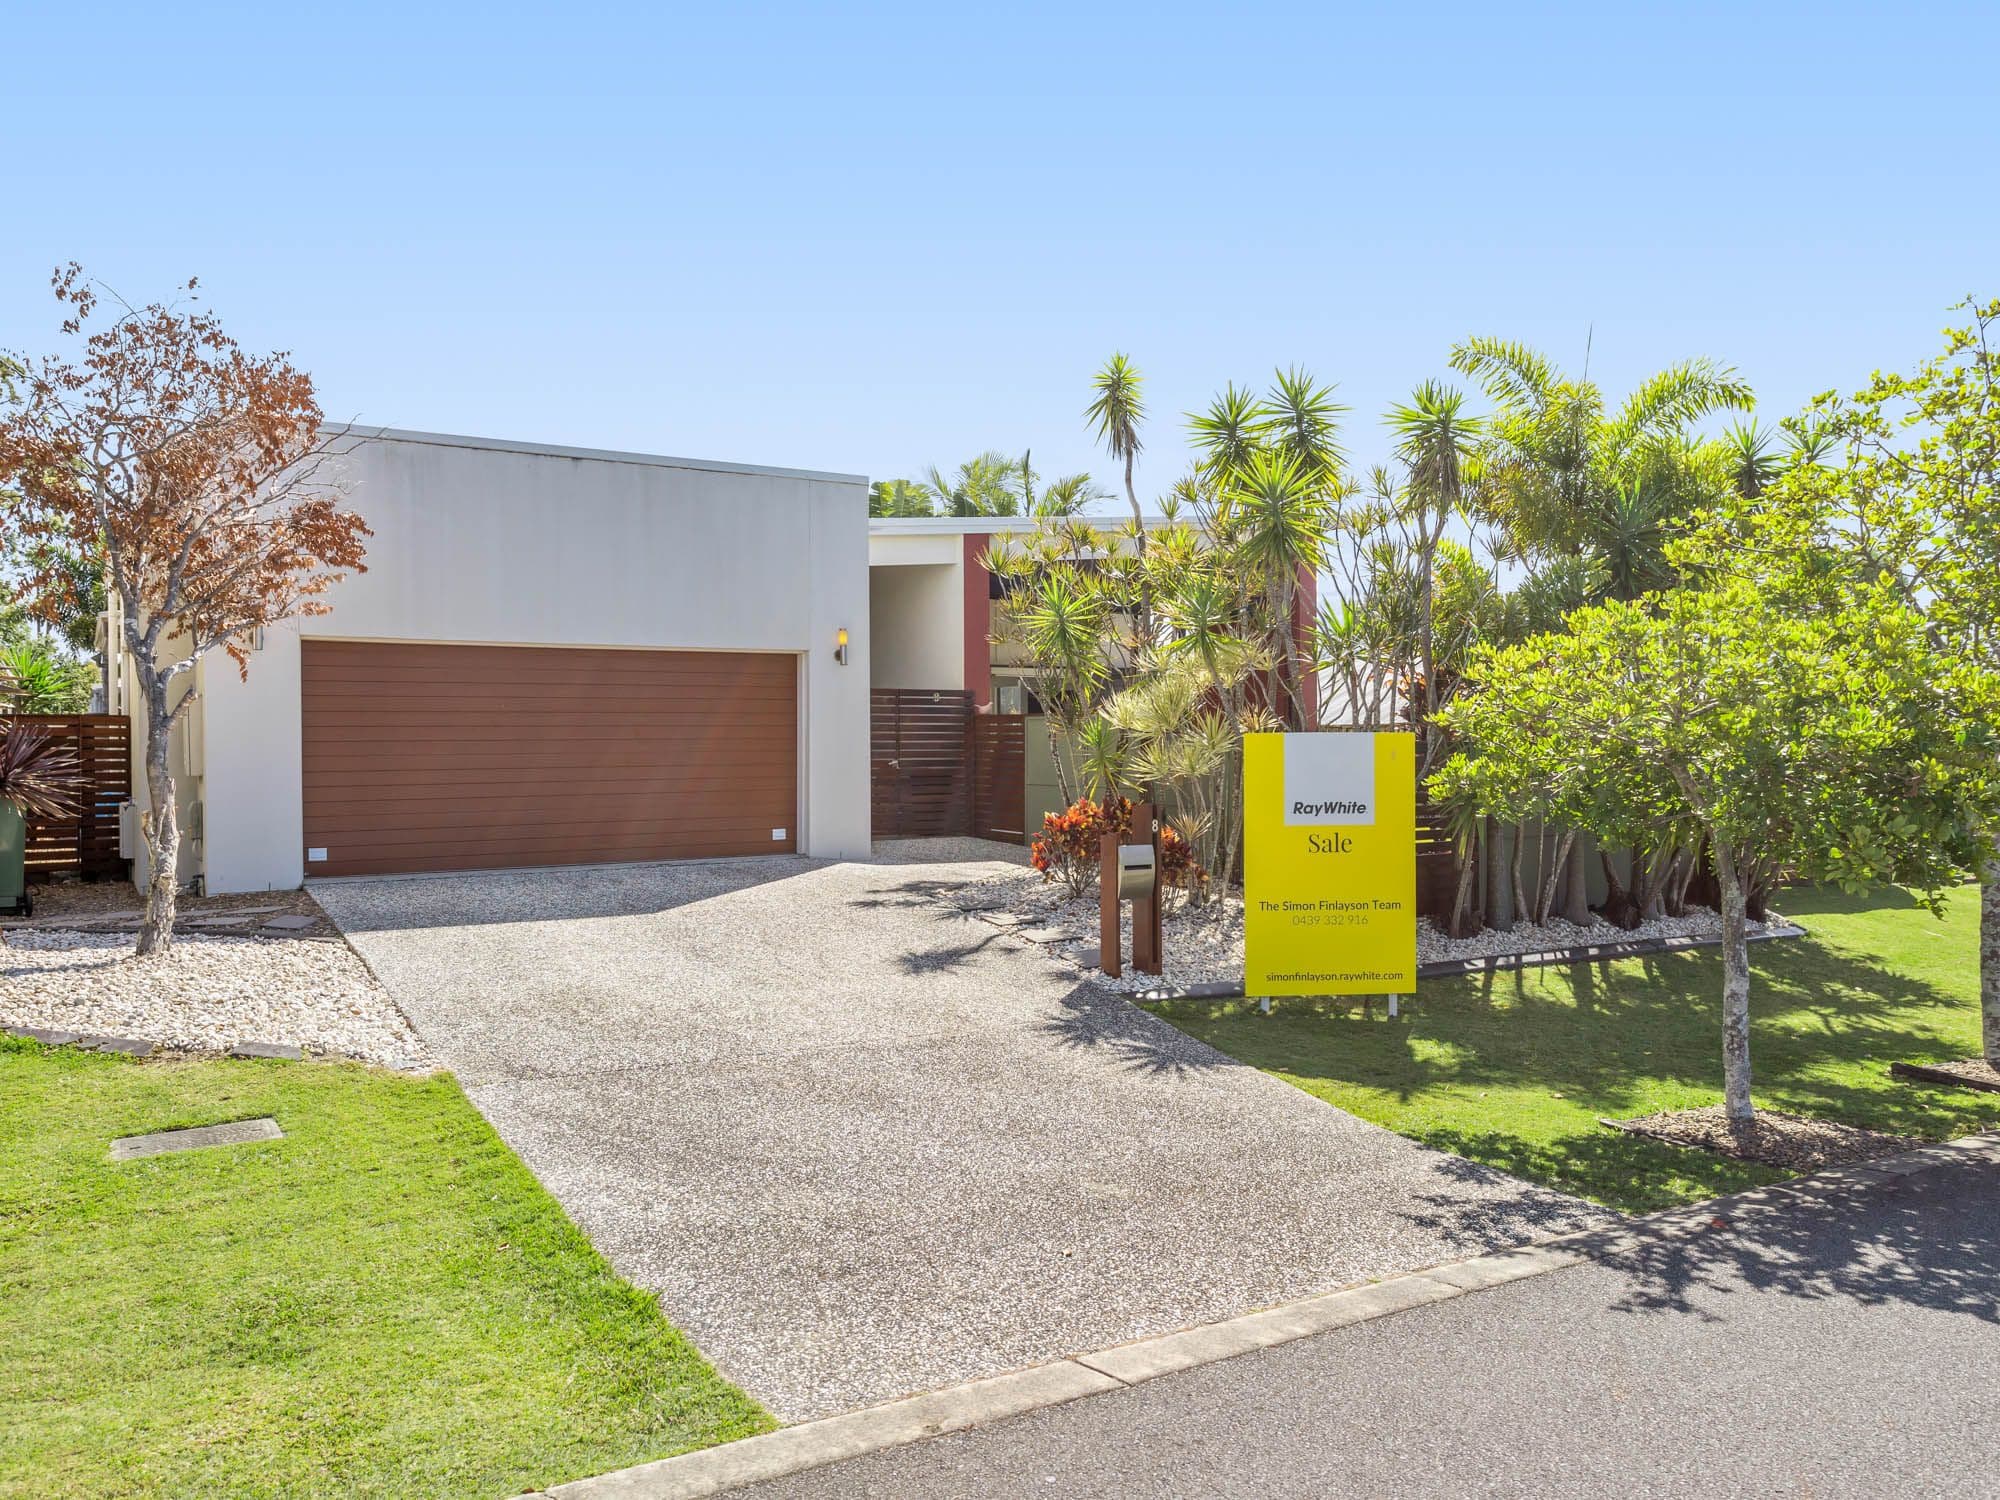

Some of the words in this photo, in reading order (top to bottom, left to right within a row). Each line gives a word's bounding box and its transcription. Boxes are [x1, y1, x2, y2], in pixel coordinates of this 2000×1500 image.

[1152, 819, 1159, 832] 8
[1308, 832, 1352, 853] Sale
[1259, 901, 1279, 911] The
[1282, 901, 1316, 911] Simon
[1319, 900, 1369, 912] Finlayson
[1372, 900, 1401, 910] Team
[1292, 915, 1321, 926] 0439
[1324, 915, 1344, 925] 332
[1347, 915, 1369, 925] 916
[1266, 971, 1403, 983] simonfinlayson.raywhite.com
